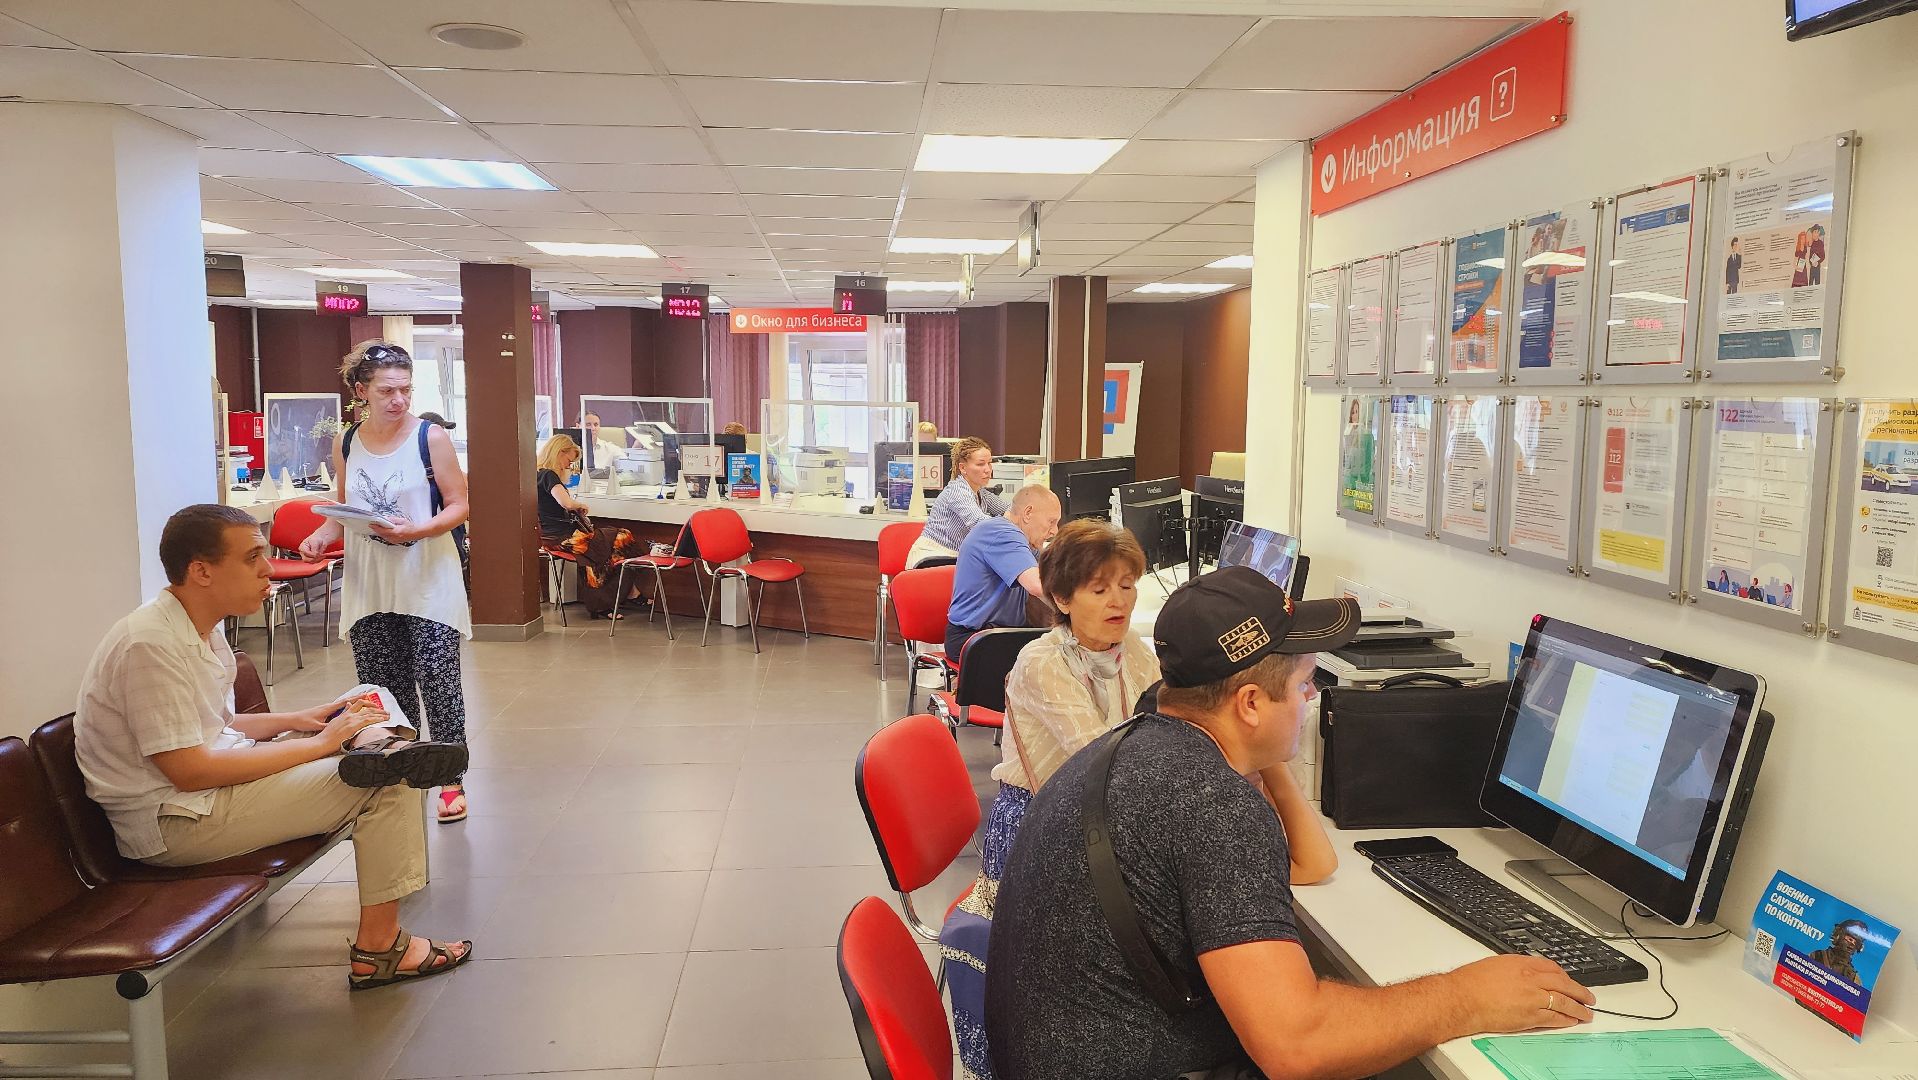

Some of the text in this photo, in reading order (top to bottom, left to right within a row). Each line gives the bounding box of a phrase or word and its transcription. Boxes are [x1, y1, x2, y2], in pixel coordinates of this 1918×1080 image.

[1341, 95, 1481, 185] Информация
[205, 257, 218, 265] 20
[337, 284, 349, 293] 19
[854, 279, 866, 287] 16
[680, 286, 691, 294] 17
[751, 313, 863, 328] Окно для бизнеса
[1720, 408, 1738, 422] 122
[1869, 408, 1901, 416] Получить
[704, 455, 720, 467] 17
[1609, 454, 1621, 464] 112
[920, 465, 938, 479] 16
[1776, 882, 1815, 907] ВОЕННАЯ
[1770, 893, 1804, 916] СЛУЖБА
[1765, 903, 1824, 941] ПО КОНТРАКТУ
